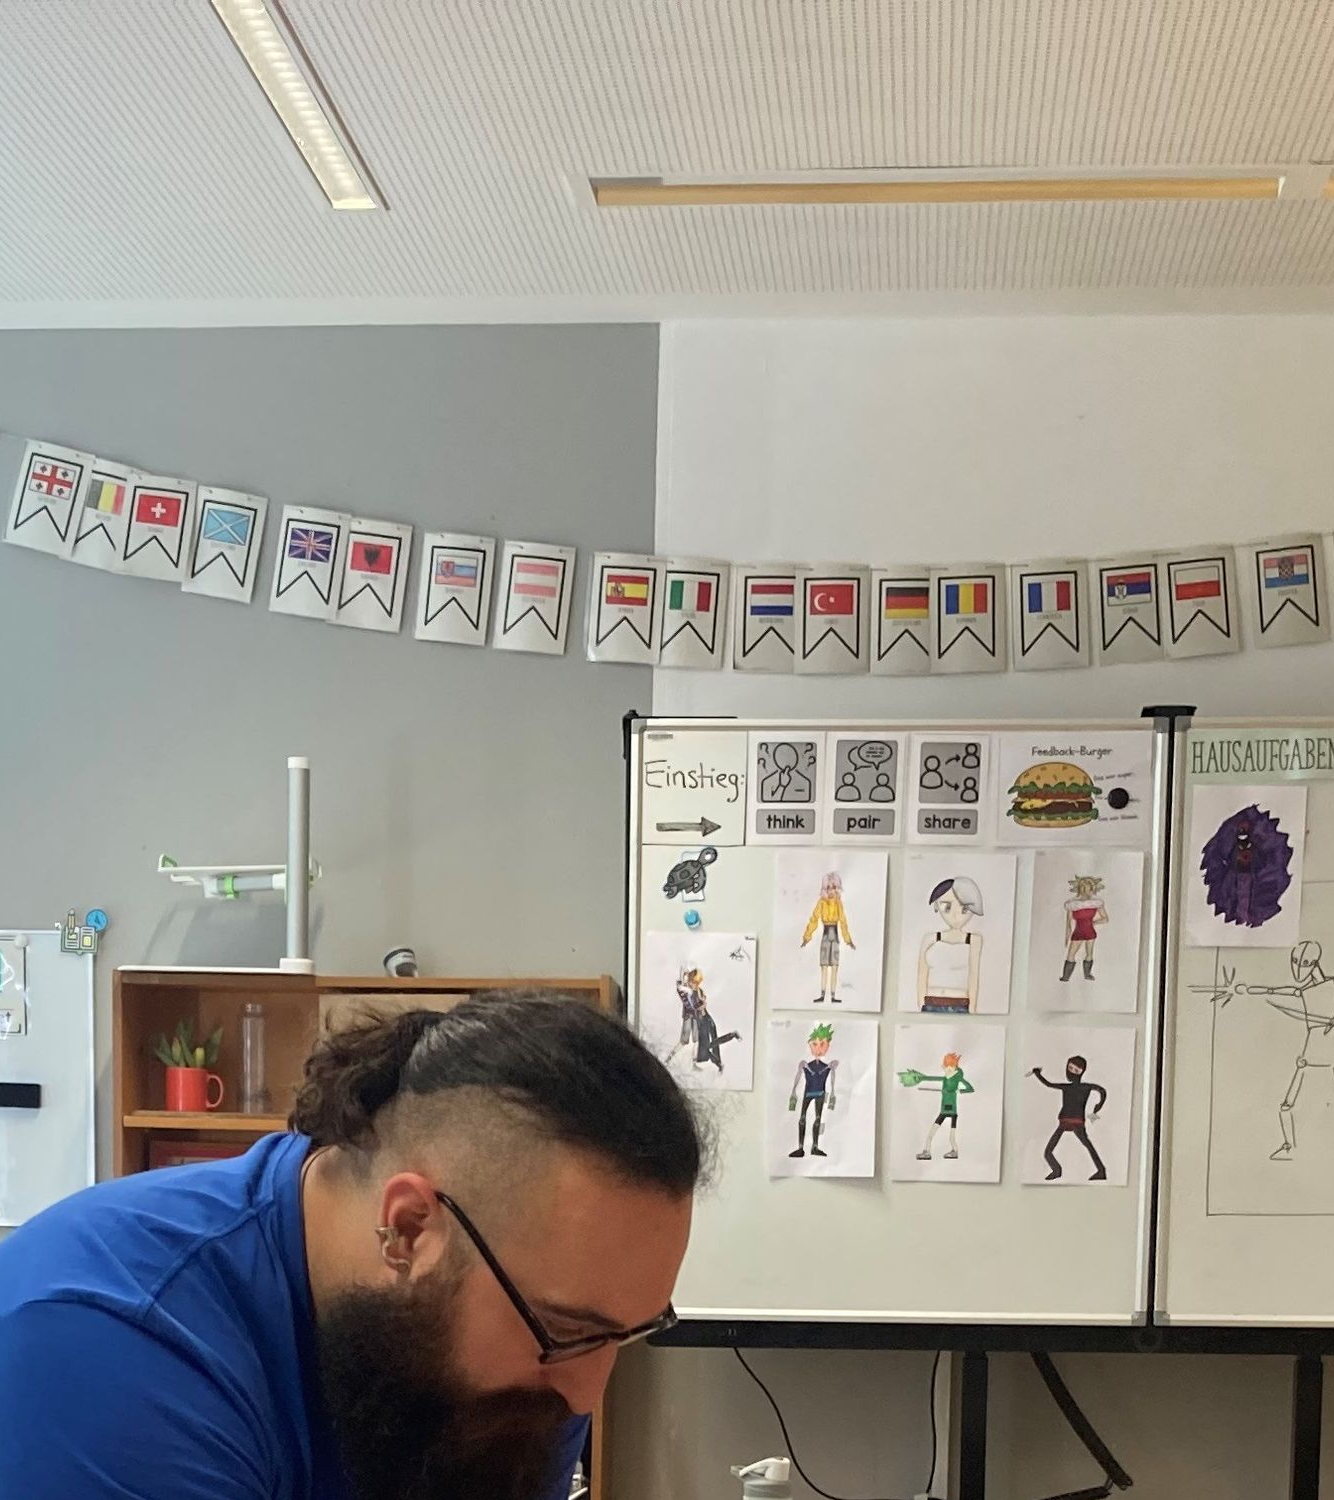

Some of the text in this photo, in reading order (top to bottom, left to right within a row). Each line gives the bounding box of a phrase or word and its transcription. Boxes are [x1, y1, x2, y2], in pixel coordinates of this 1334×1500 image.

[1031, 745, 1113, 760] Feedback-Burger
[644, 760, 746, 803] Einstieg:
[766, 812, 806, 831] think
[846, 812, 881, 835] pair
[923, 812, 972, 831] share
